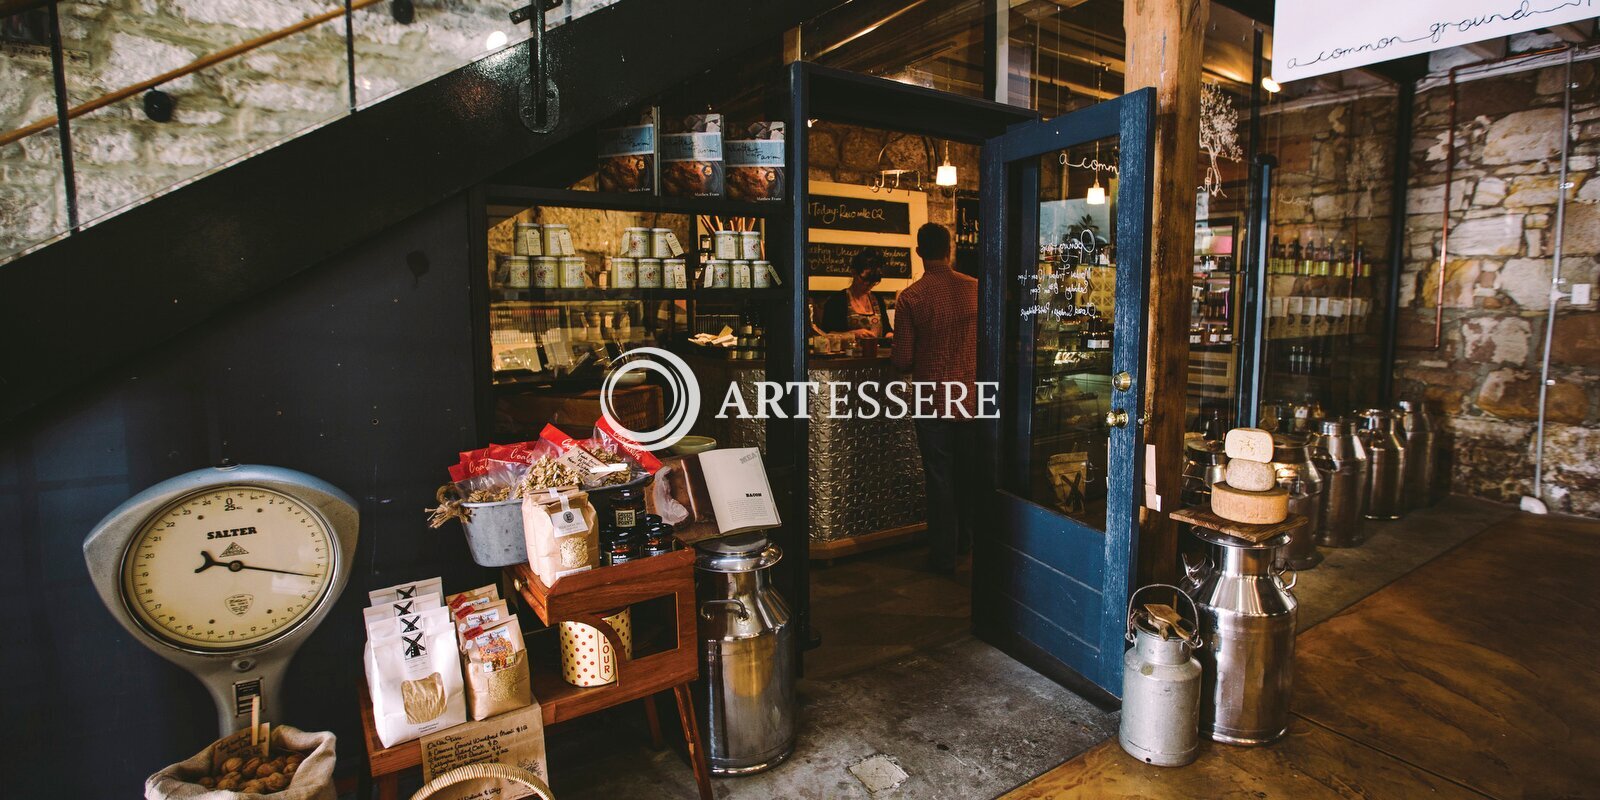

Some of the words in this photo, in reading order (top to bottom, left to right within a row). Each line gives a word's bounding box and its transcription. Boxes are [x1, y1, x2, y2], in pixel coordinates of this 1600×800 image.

[1287, 58, 1297, 69] a
[1318, 36, 1402, 62] common
[1430, 0, 1532, 43] ground
[207, 526, 257, 540] SALTER
